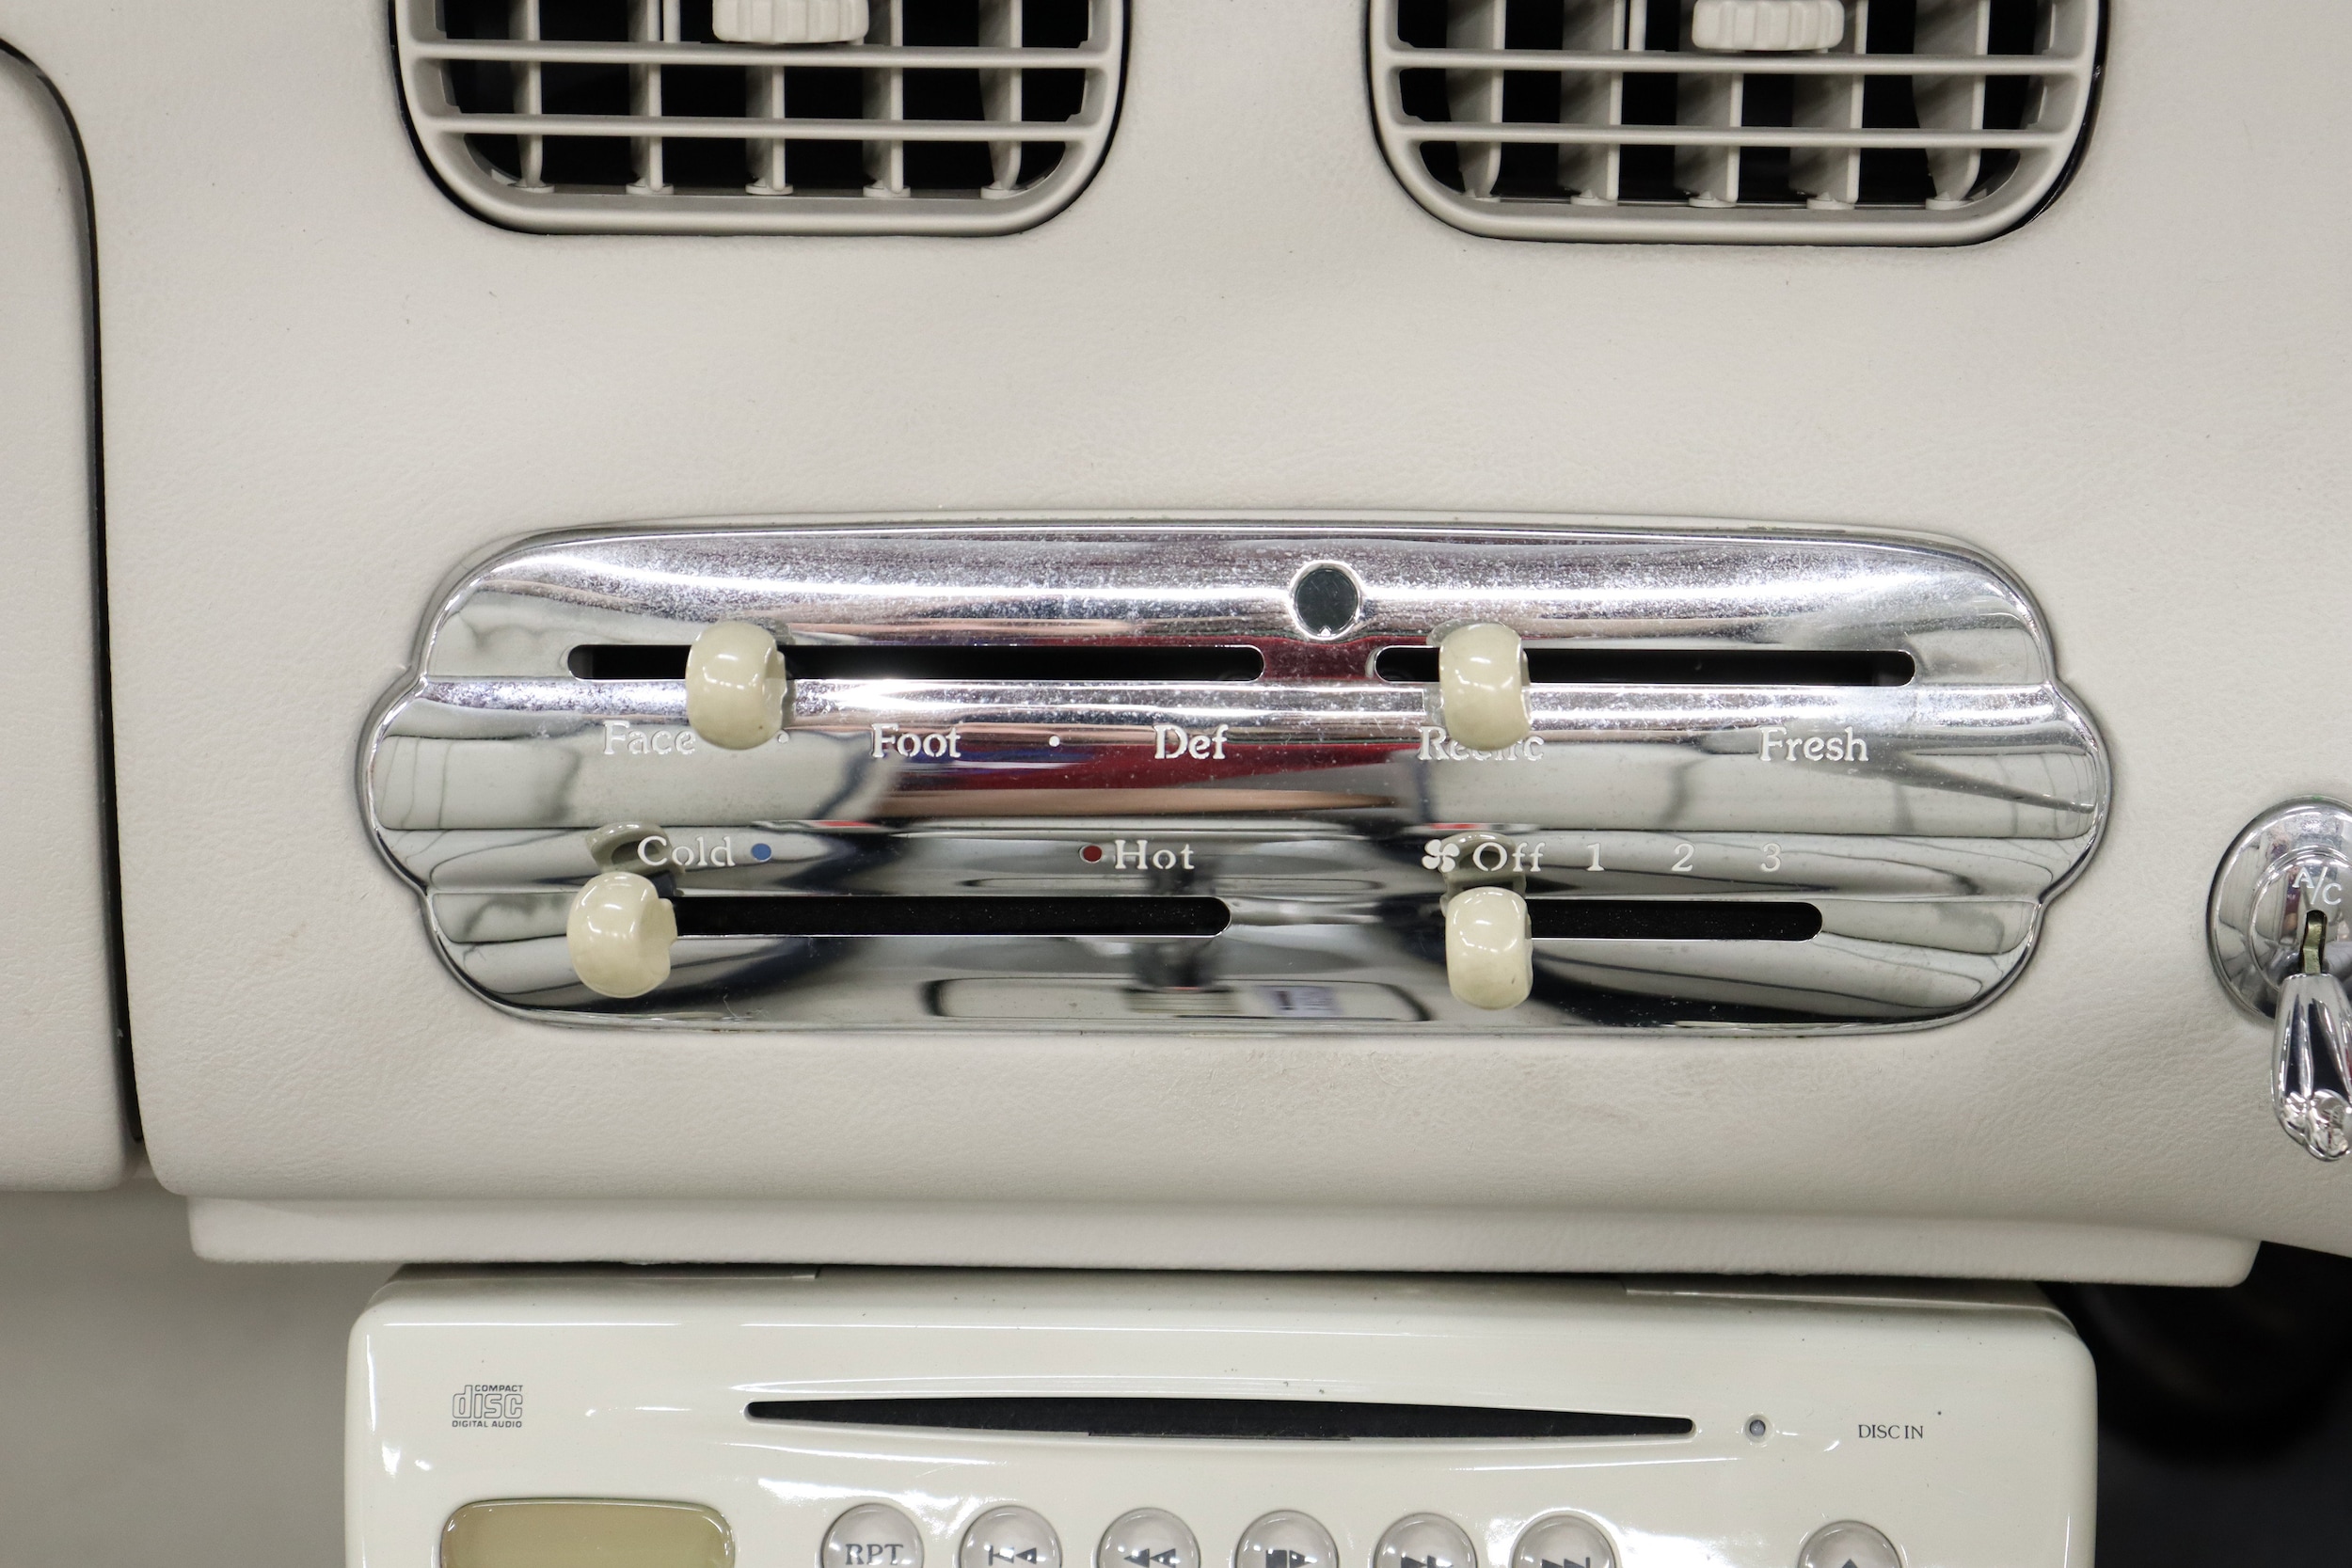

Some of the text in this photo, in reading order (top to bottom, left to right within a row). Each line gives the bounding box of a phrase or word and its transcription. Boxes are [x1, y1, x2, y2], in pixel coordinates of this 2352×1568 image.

[602, 720, 1230, 760] Face Foot Def
[1758, 725, 1869, 763] Fresh
[636, 835, 1195, 871] Cold Hot
[1472, 841, 1782, 873] Off 1 2 3
[2292, 865, 2343, 906] A/C
[452, 1384, 524, 1419] disc
[1858, 1424, 1923, 1439] DISC IN
[845, 1543, 904, 1566] RPT
